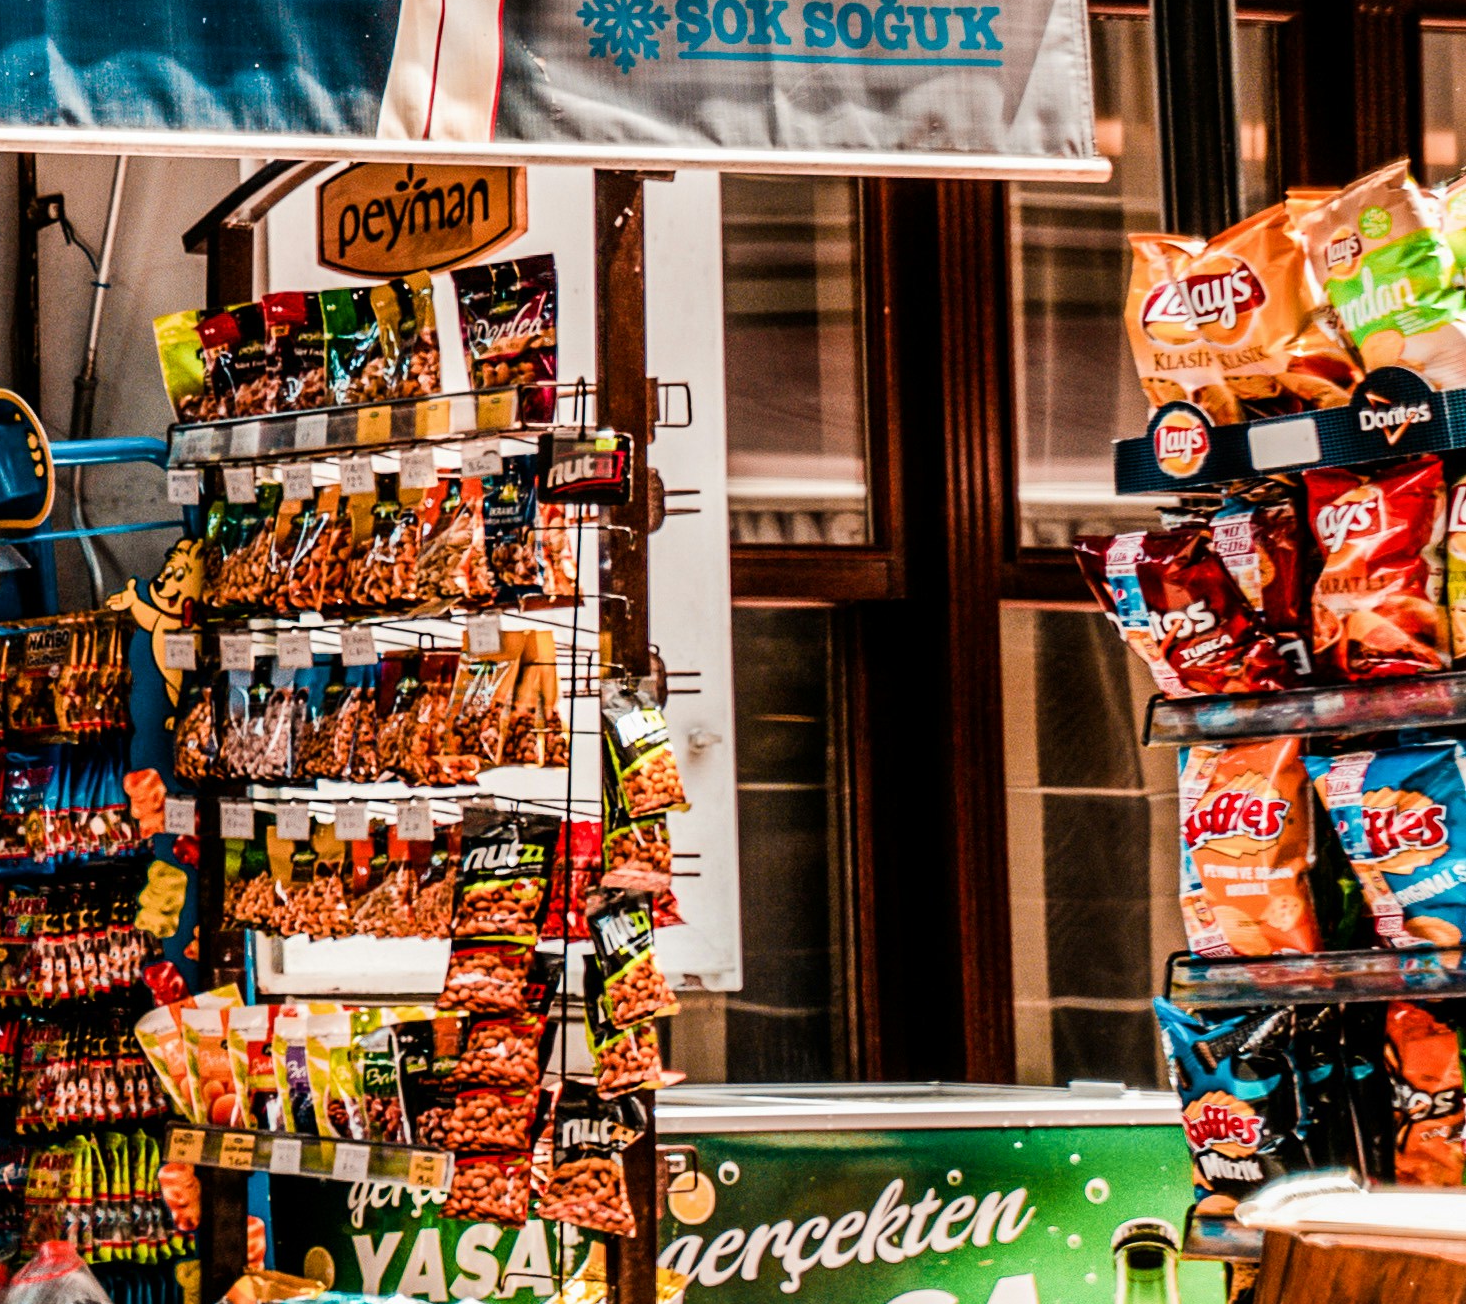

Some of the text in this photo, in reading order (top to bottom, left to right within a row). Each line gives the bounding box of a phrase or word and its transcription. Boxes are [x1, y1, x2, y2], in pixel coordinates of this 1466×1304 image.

[339, 177, 489, 258] peyman
[1158, 425, 1205, 462] Lay's
[1359, 403, 1432, 432] Doritos
[1316, 496, 1378, 553] ay's
[1184, 788, 1291, 851] uffles
